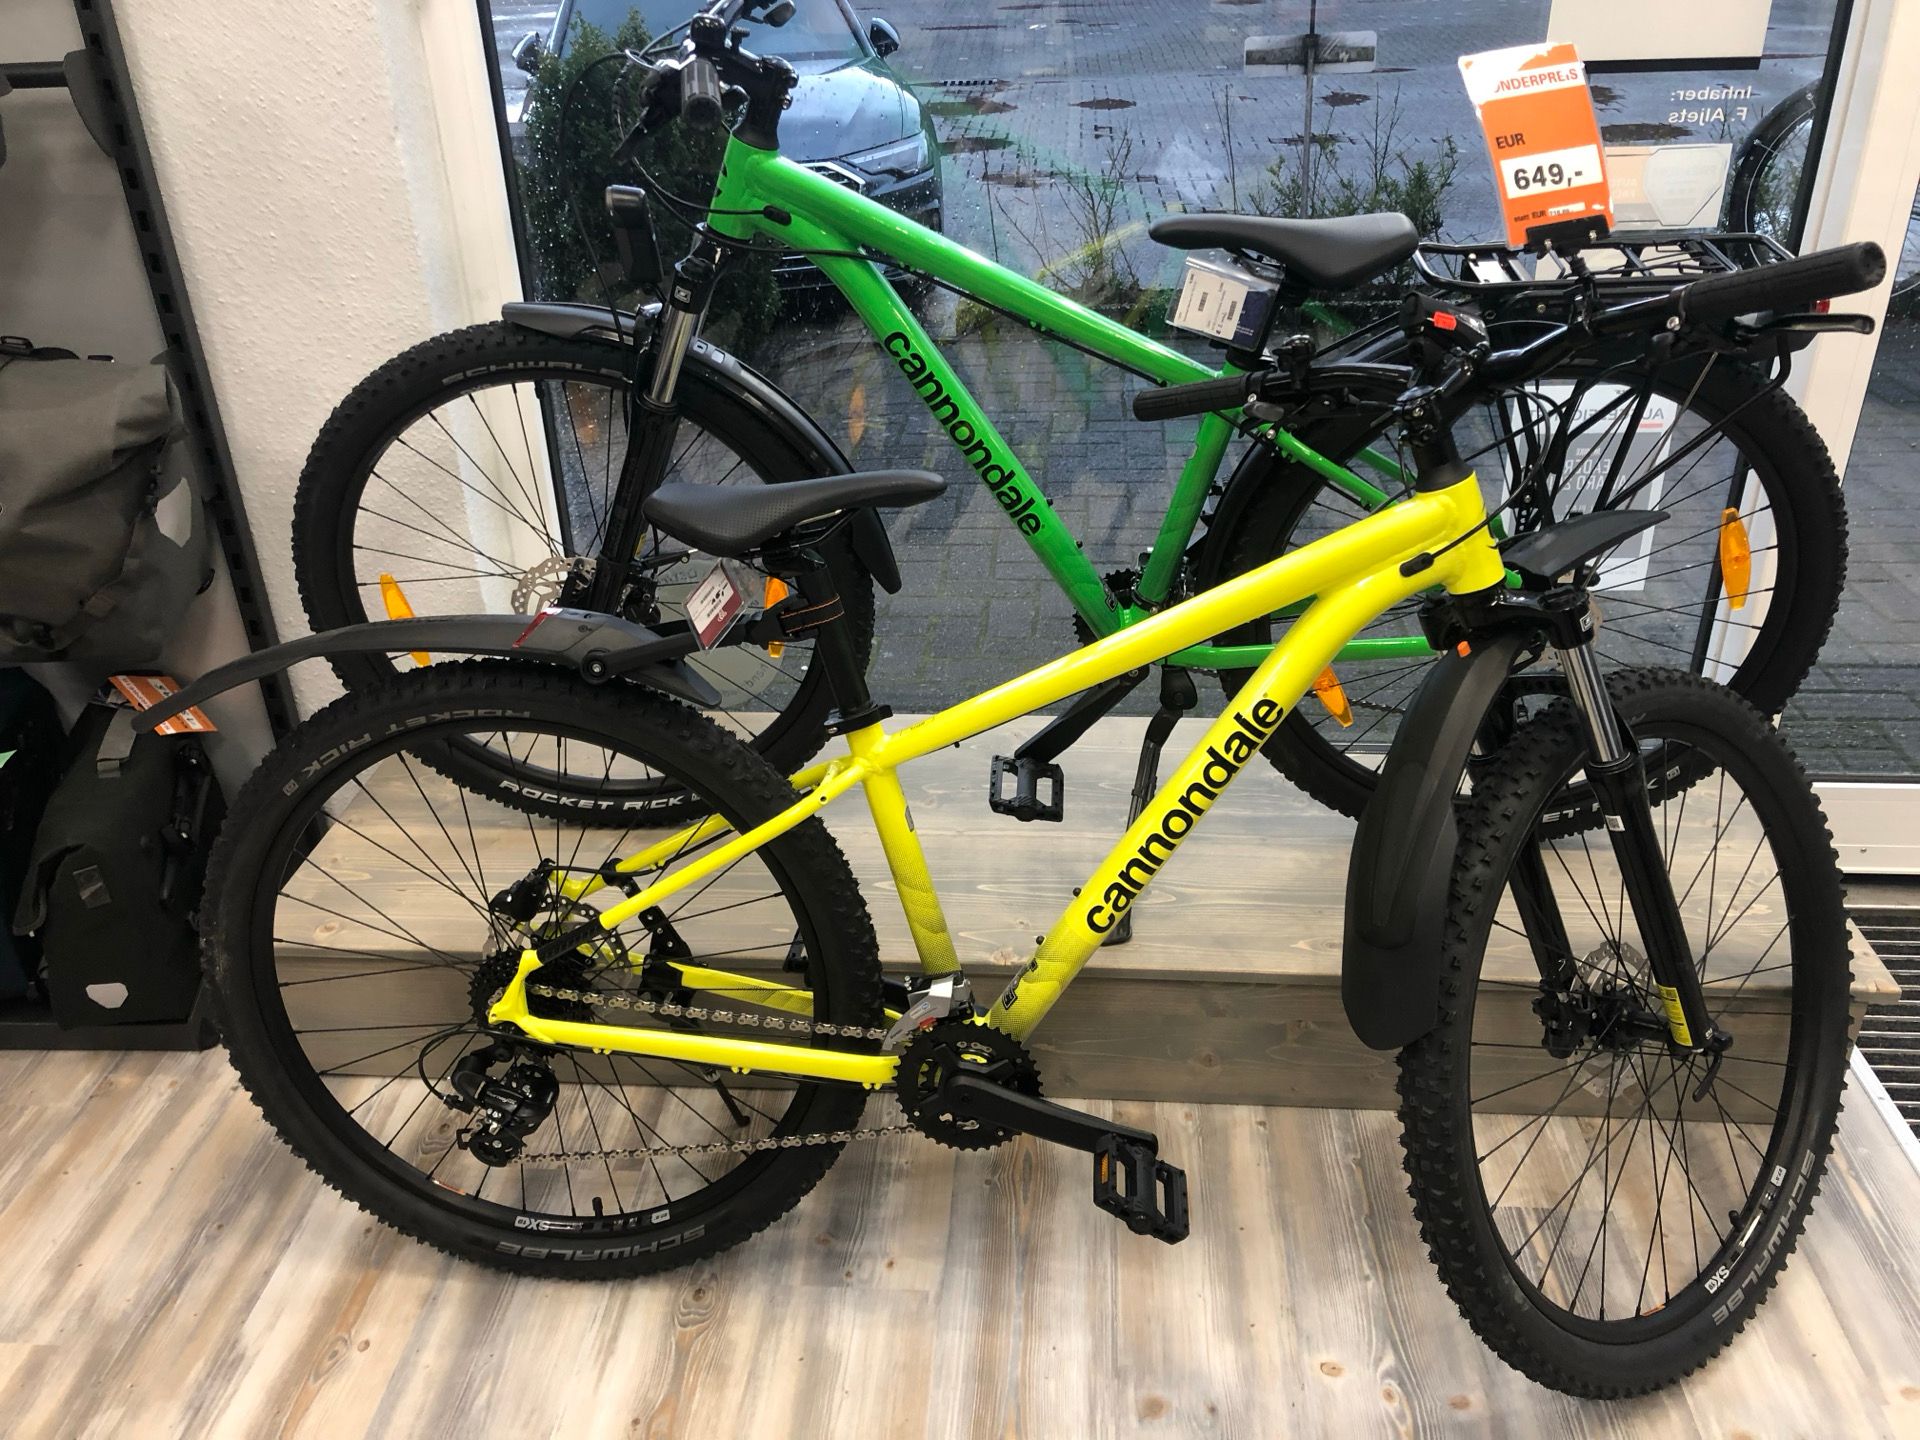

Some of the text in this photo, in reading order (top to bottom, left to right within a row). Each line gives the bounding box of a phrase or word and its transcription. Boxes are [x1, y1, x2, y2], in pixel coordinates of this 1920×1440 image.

[1493, 68, 1579, 93] NDERPRES
[1495, 132, 1526, 150] EUR
[1513, 163, 1584, 190] 649,-
[1531, 209, 1547, 219] EUR
[884, 331, 1042, 537] cannondale
[300, 732, 372, 780] RICK
[499, 779, 686, 812] ROCKET RICK
[1086, 698, 1284, 934] cannondale
[495, 1224, 706, 1262] SCHWALBE
[1711, 1149, 1816, 1327] SCHWALBE
